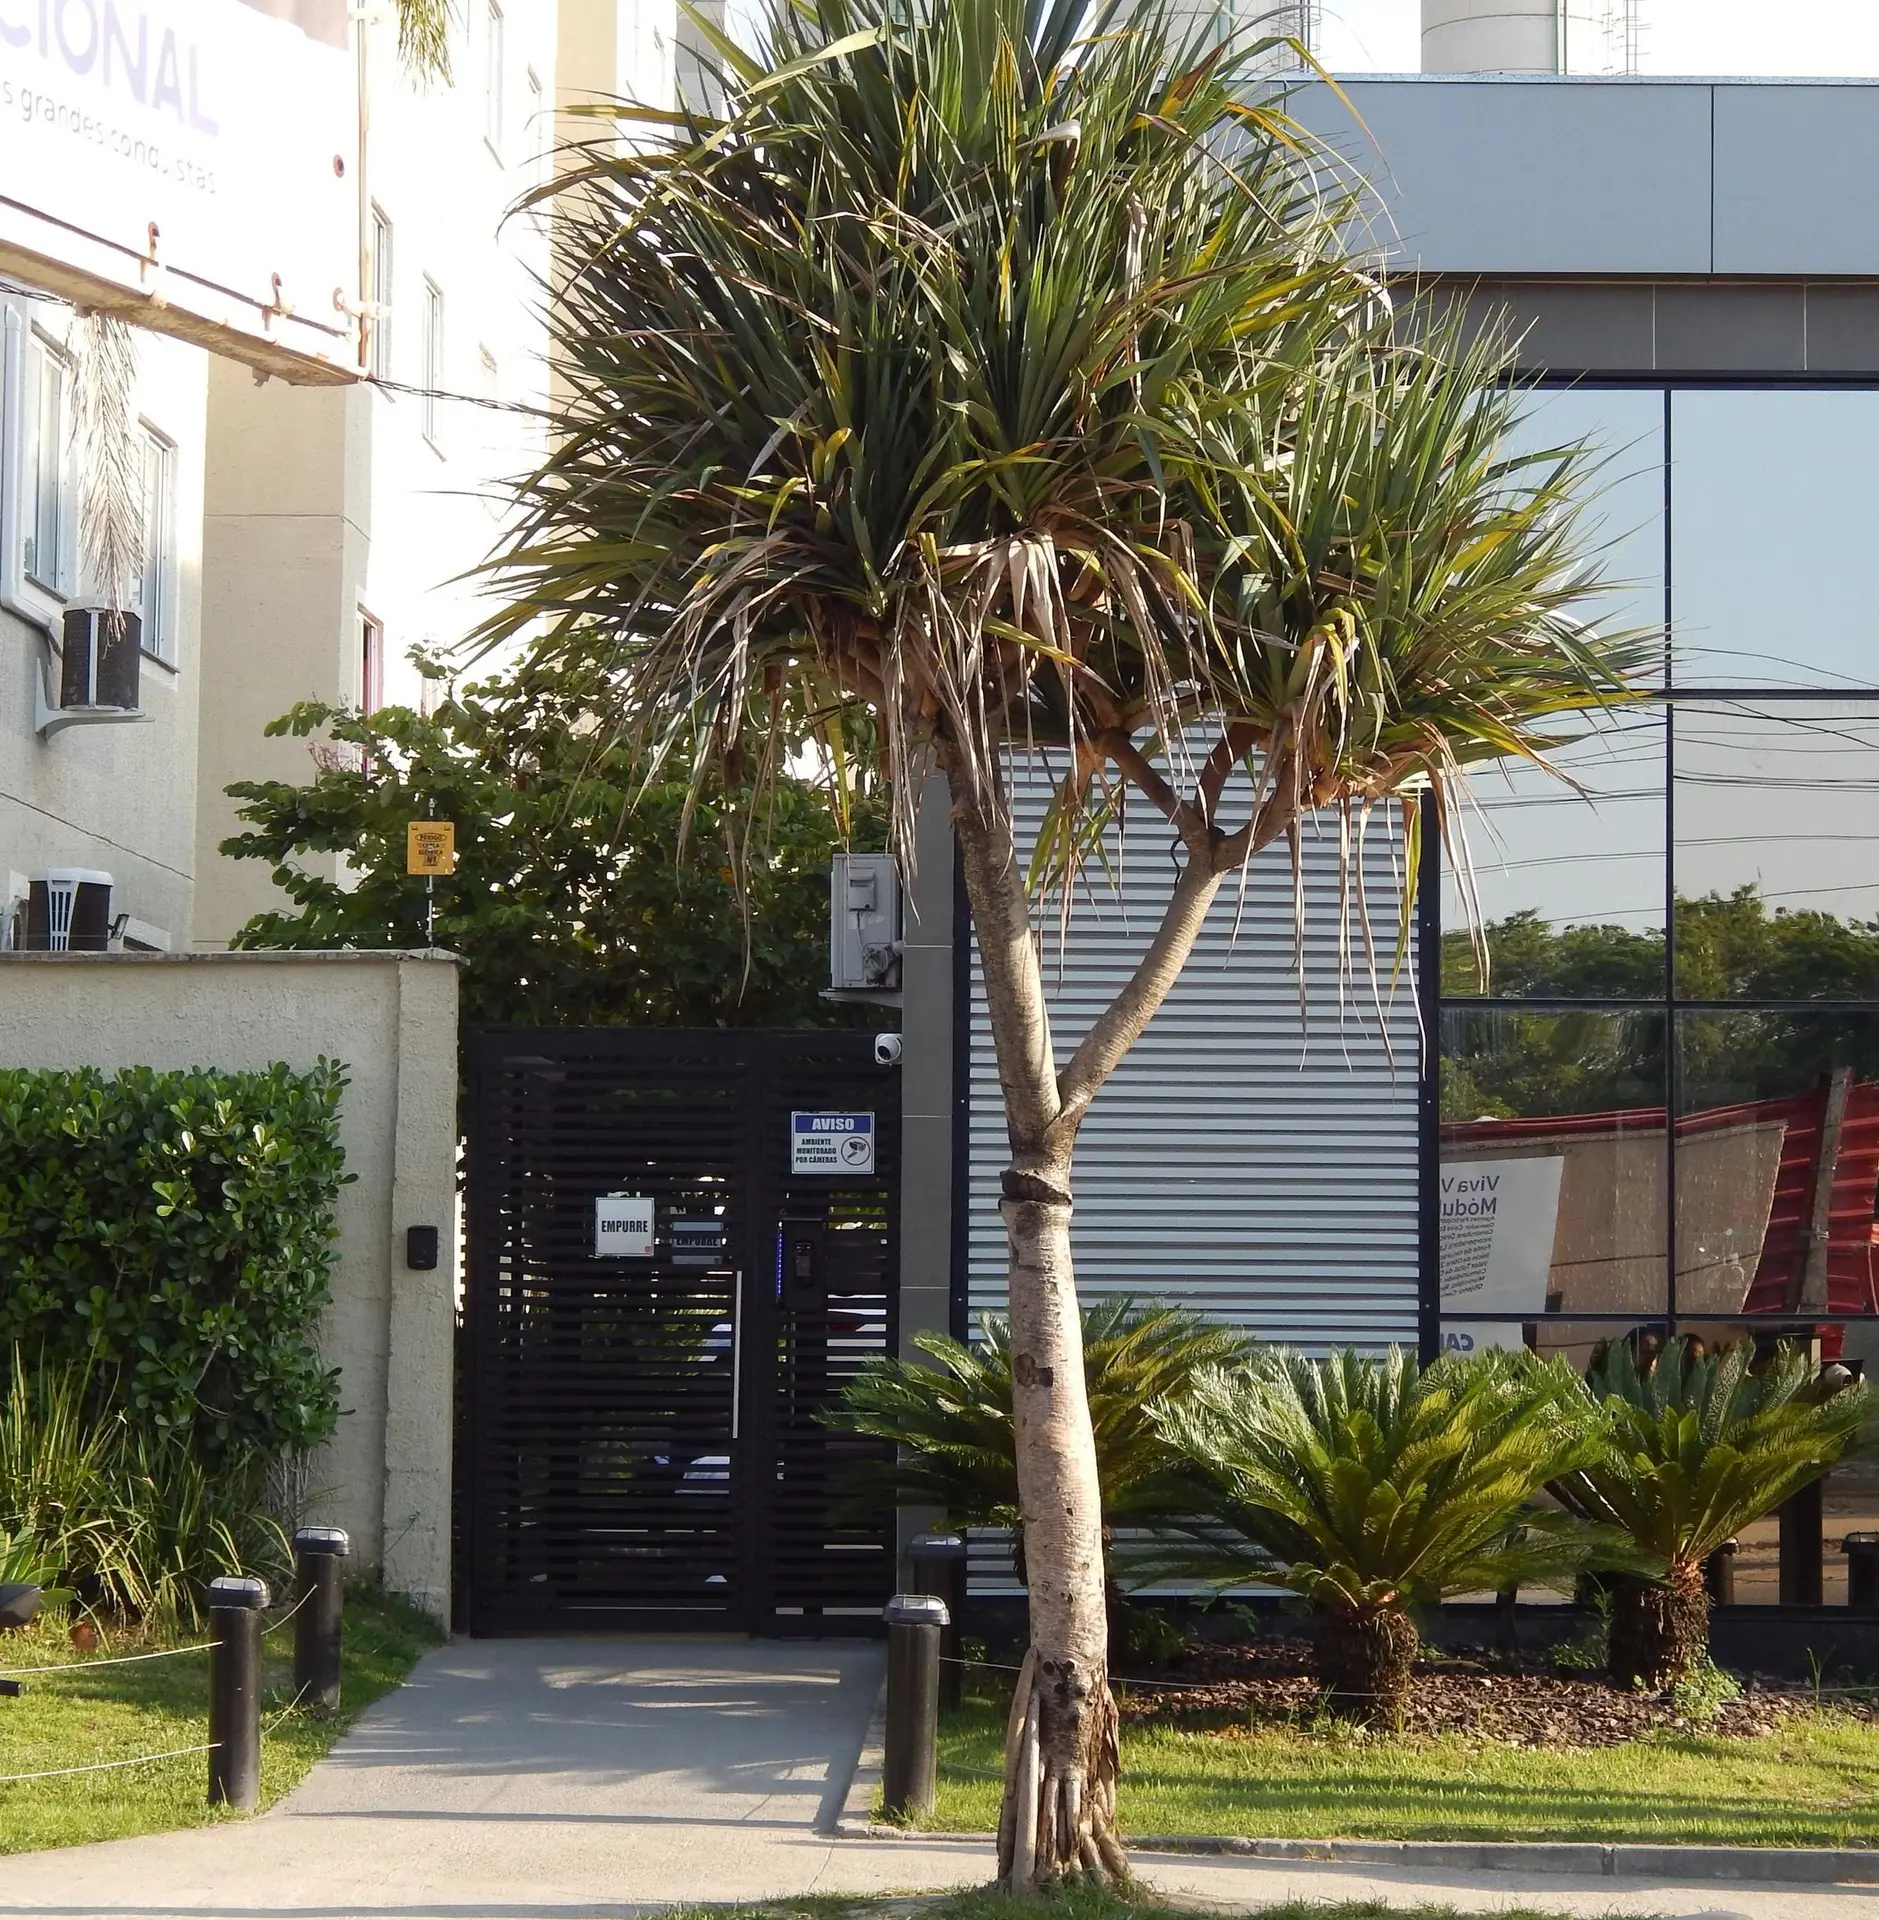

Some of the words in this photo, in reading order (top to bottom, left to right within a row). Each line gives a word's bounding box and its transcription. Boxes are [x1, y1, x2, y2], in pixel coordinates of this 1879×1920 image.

[20, 88, 104, 145] grandes
[812, 1118, 855, 1130] AVISO
[808, 1155, 838, 1163] CÂMERAS
[601, 1220, 648, 1233] EMPURRE
